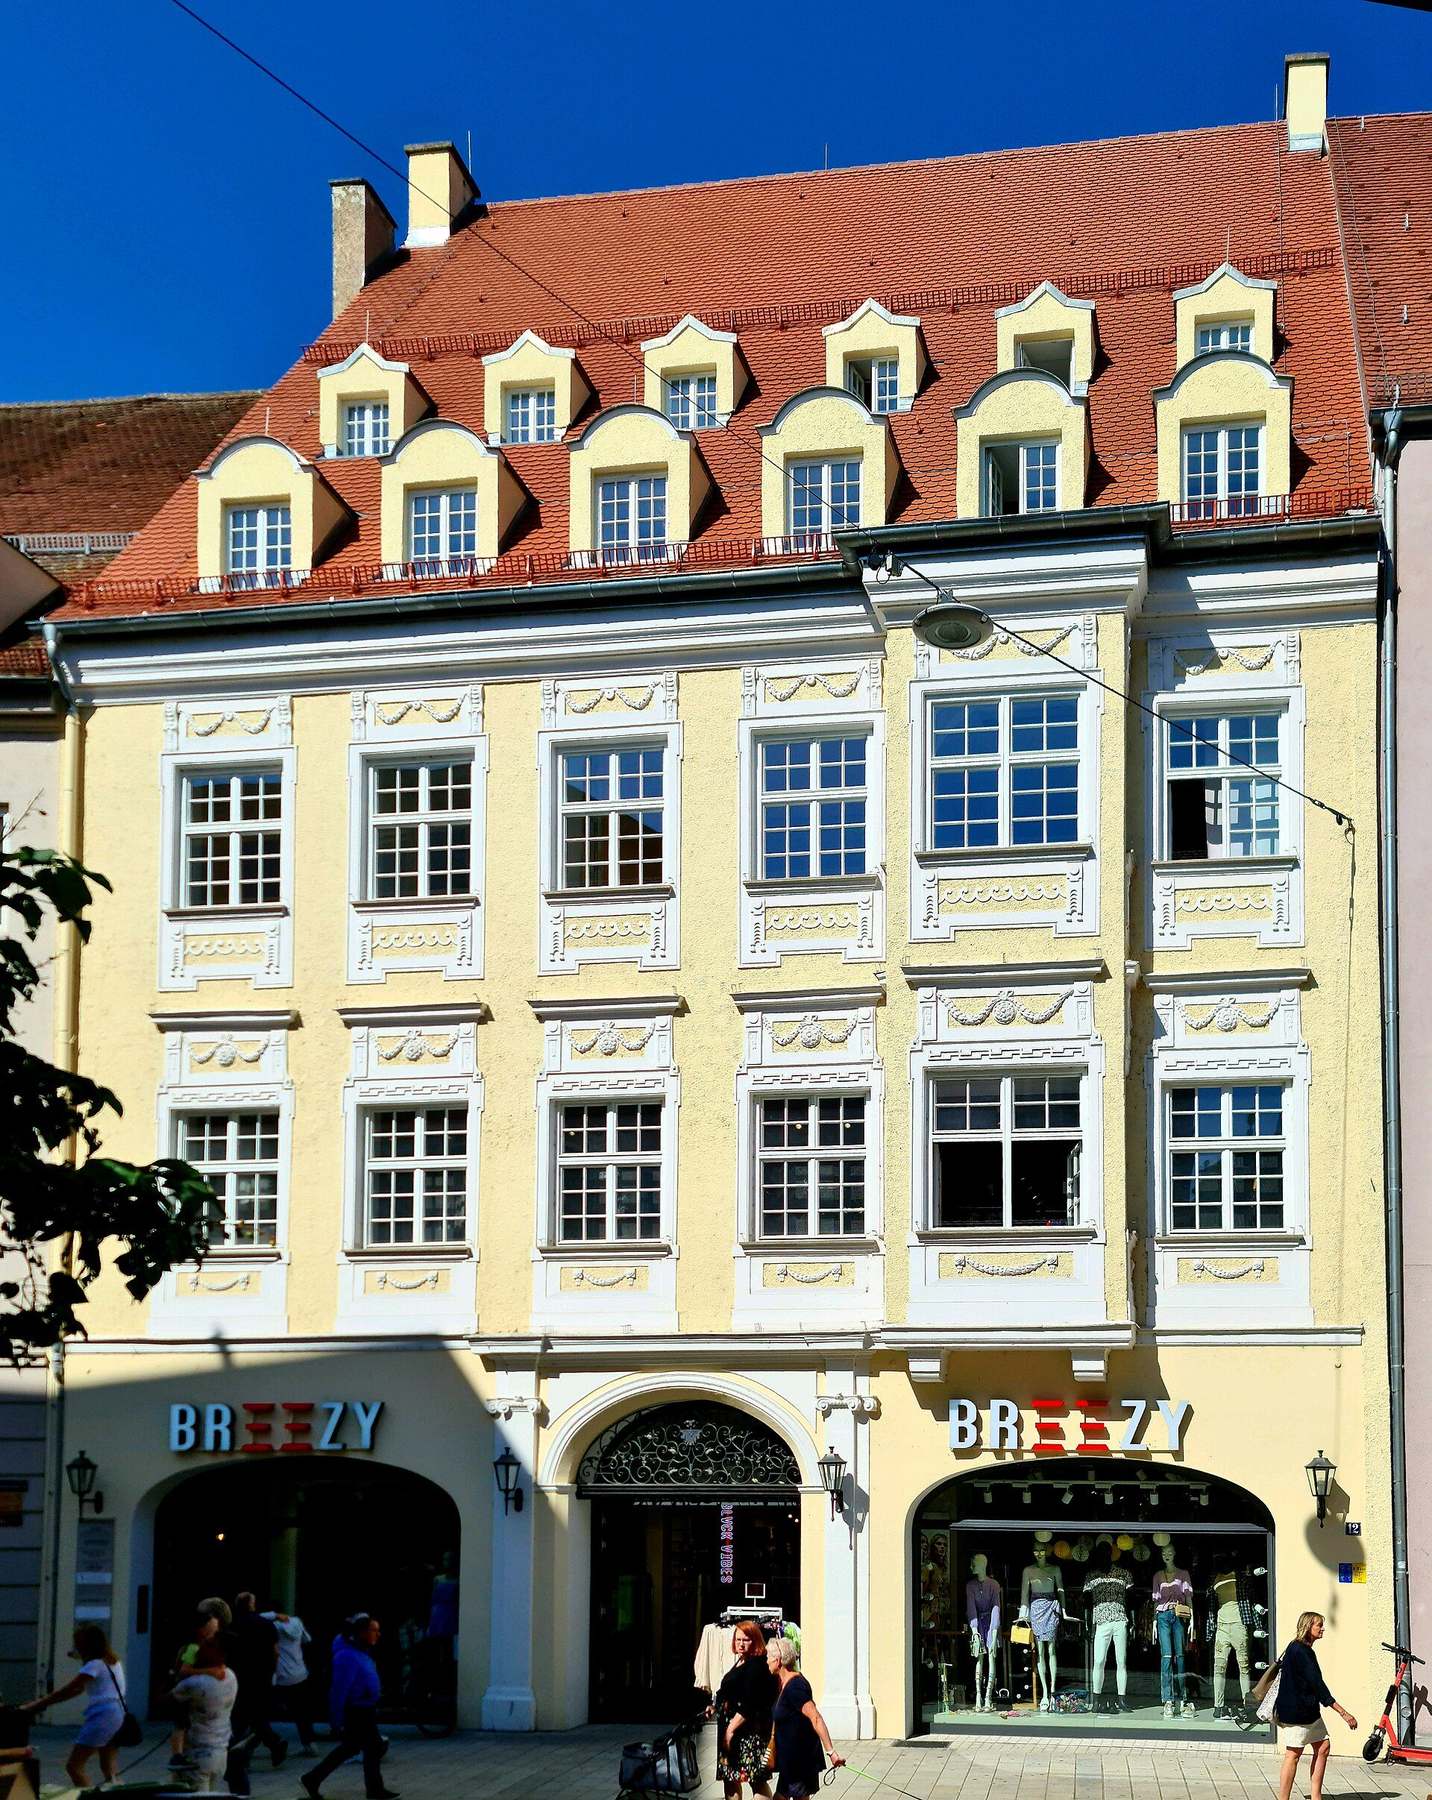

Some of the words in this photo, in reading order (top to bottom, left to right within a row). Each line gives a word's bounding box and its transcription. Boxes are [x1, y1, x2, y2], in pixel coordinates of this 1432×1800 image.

[169, 1402, 383, 1453] BREEZY
[948, 1399, 1190, 1452] BREEZY
[1347, 1523, 1359, 1534] 12
[720, 1545, 733, 1584] VIBES
